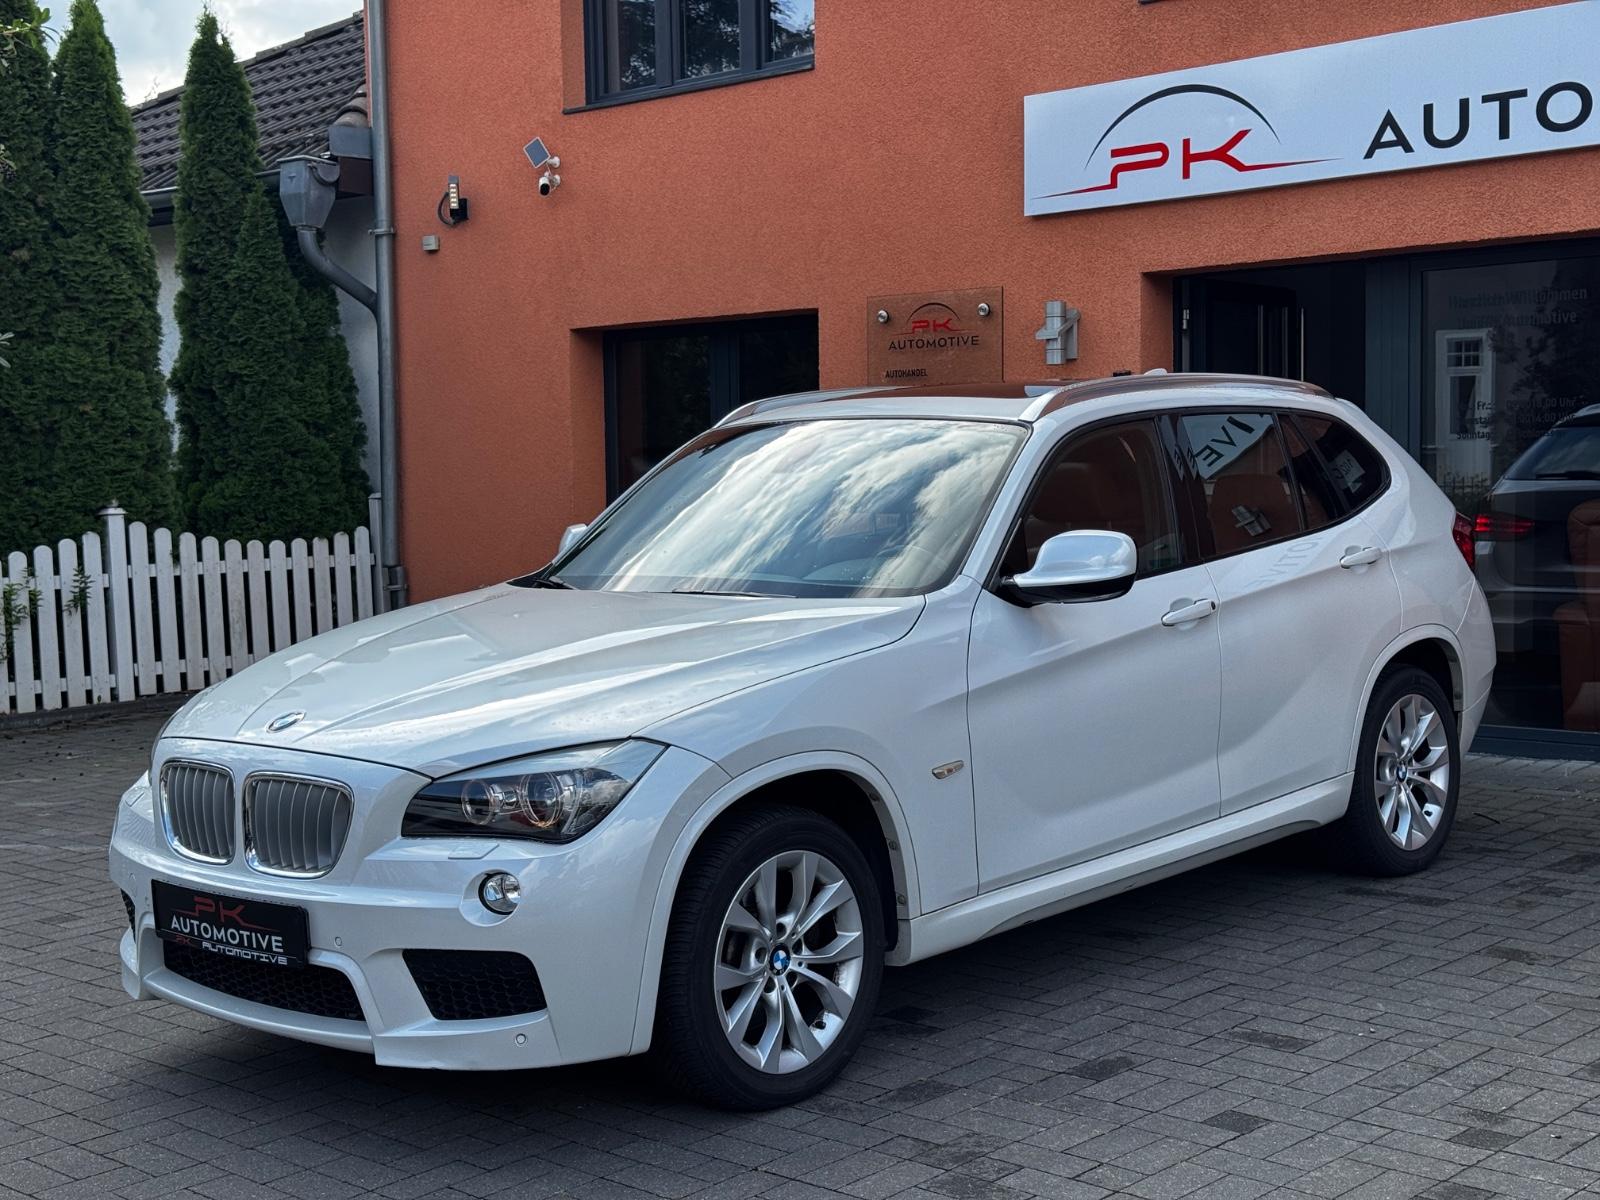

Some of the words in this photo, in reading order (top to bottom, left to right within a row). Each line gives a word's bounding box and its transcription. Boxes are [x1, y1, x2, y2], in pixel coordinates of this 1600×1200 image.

[1362, 81, 1594, 160] AUTO
[888, 335, 980, 351] AUTOMOTIVE
[885, 368, 928, 379] AUTOHANDEL
[171, 914, 284, 953] AUTOMOTIVE
[201, 941, 288, 965] AUTOMOTIVE
